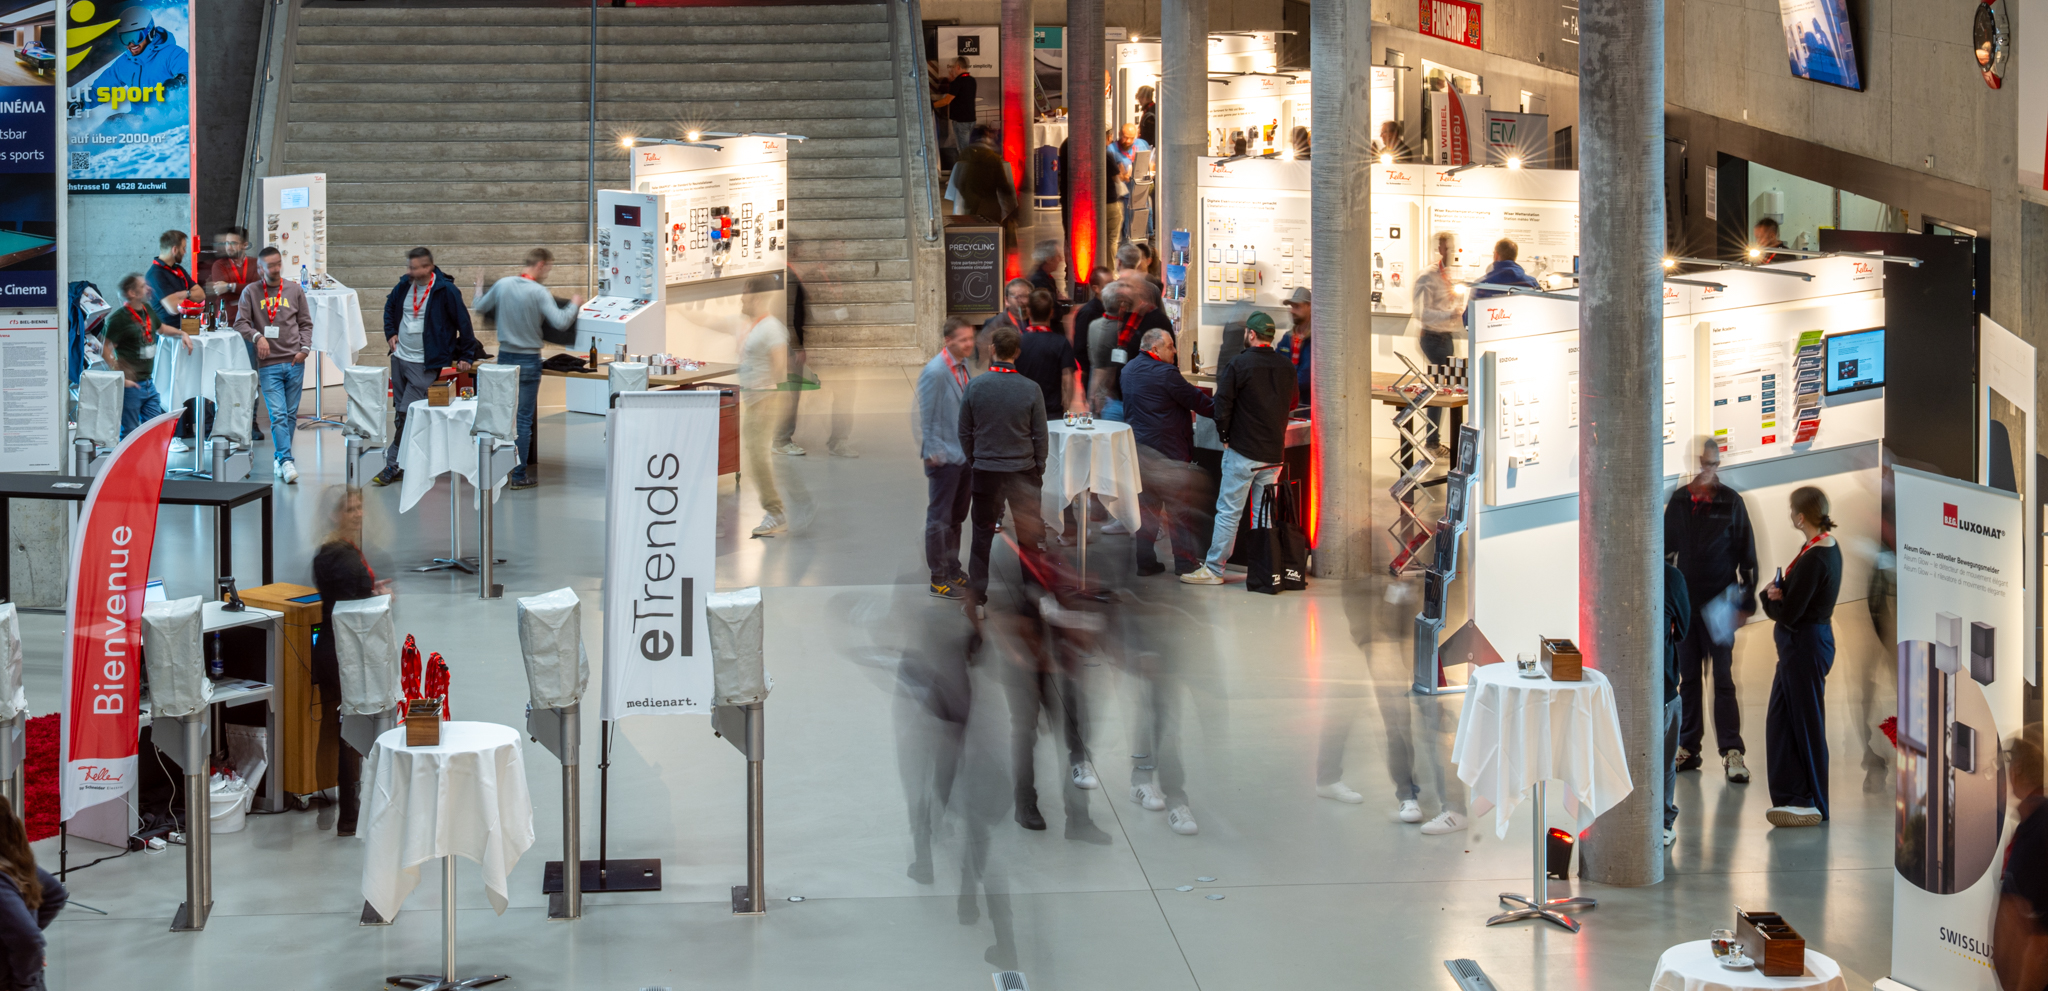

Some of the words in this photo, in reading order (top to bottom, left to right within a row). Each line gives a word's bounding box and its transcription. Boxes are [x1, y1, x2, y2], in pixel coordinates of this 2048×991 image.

[1432, 0, 1467, 43] FANSHOP
[96, 82, 165, 110] sport
[70, 133, 90, 144] auf
[91, 132, 118, 144] über
[118, 133, 149, 144] 2000
[1490, 122, 1516, 143] EM
[10, 149, 45, 163] sports
[138, 182, 167, 190] Zuchwil
[4, 284, 47, 295] Cinema
[632, 452, 680, 662] eTrends
[1919, 547, 1931, 556] Glow
[93, 526, 132, 714] Bienvenue
[626, 697, 697, 708] medienart.
[78, 765, 124, 782] Feller
